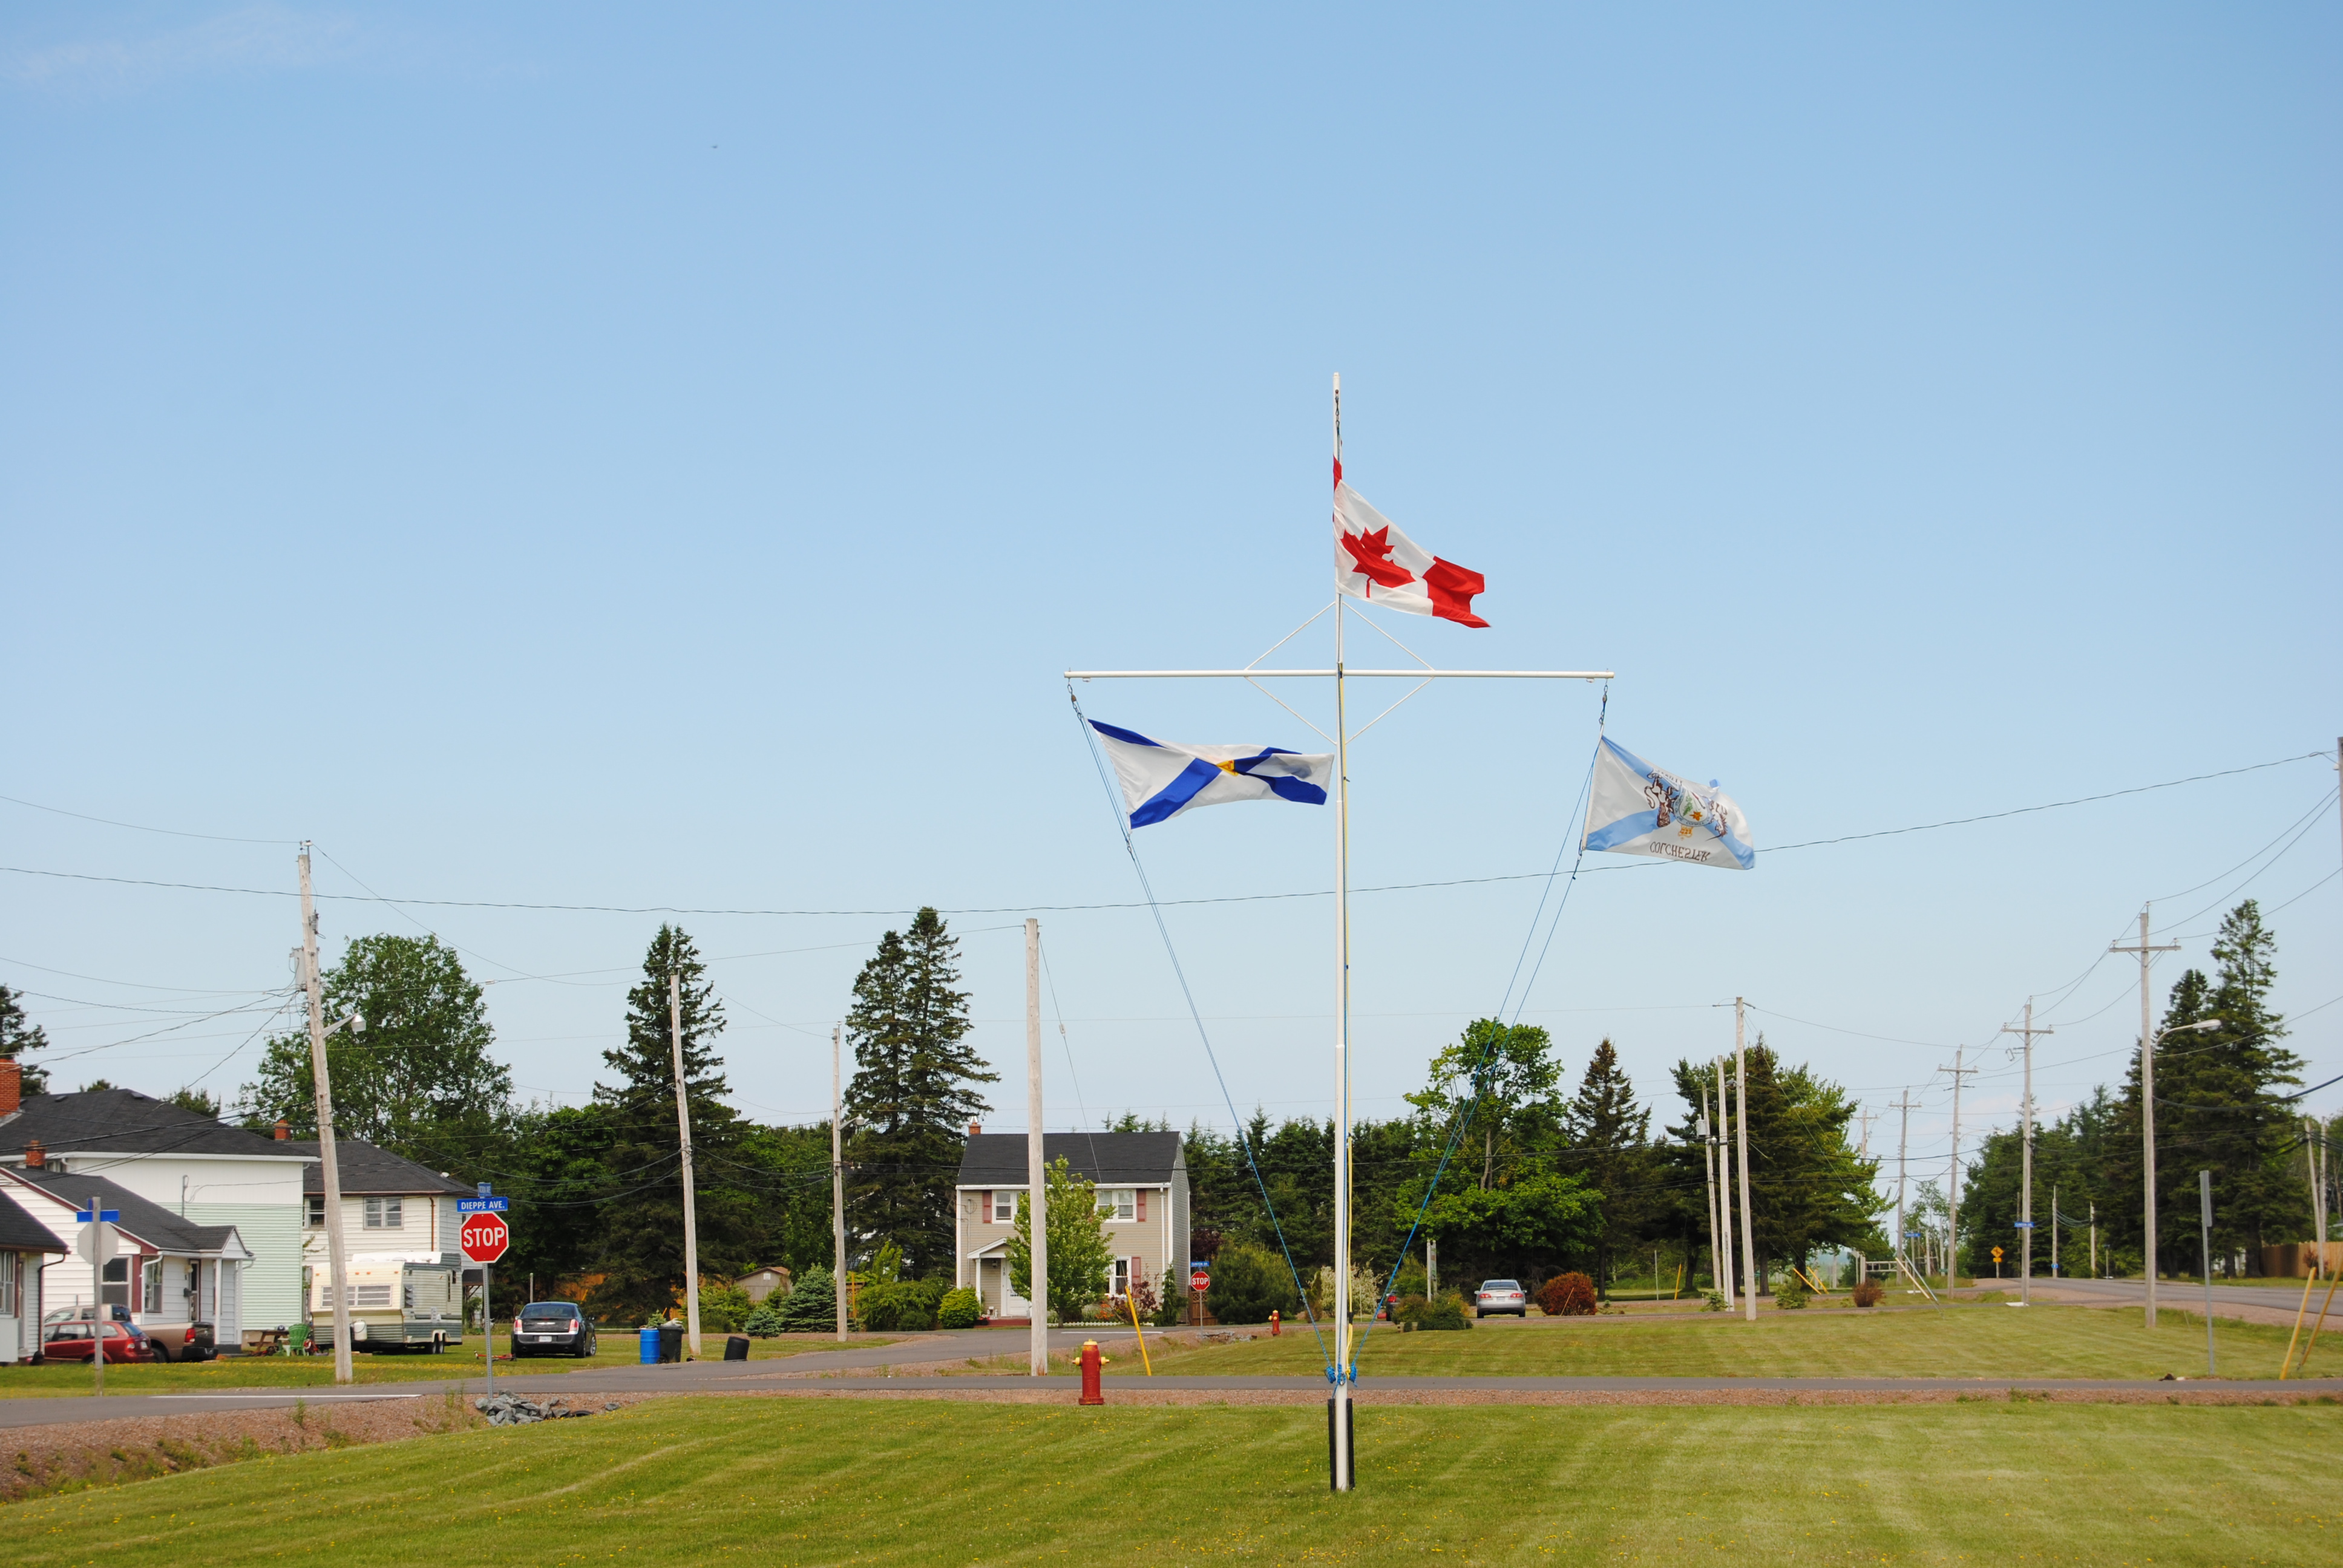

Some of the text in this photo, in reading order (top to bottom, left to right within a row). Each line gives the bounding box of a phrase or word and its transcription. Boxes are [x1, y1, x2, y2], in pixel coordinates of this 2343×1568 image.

[461, 1200, 505, 1210] DIEPPE AVE.
[464, 1227, 505, 1247] STOP
